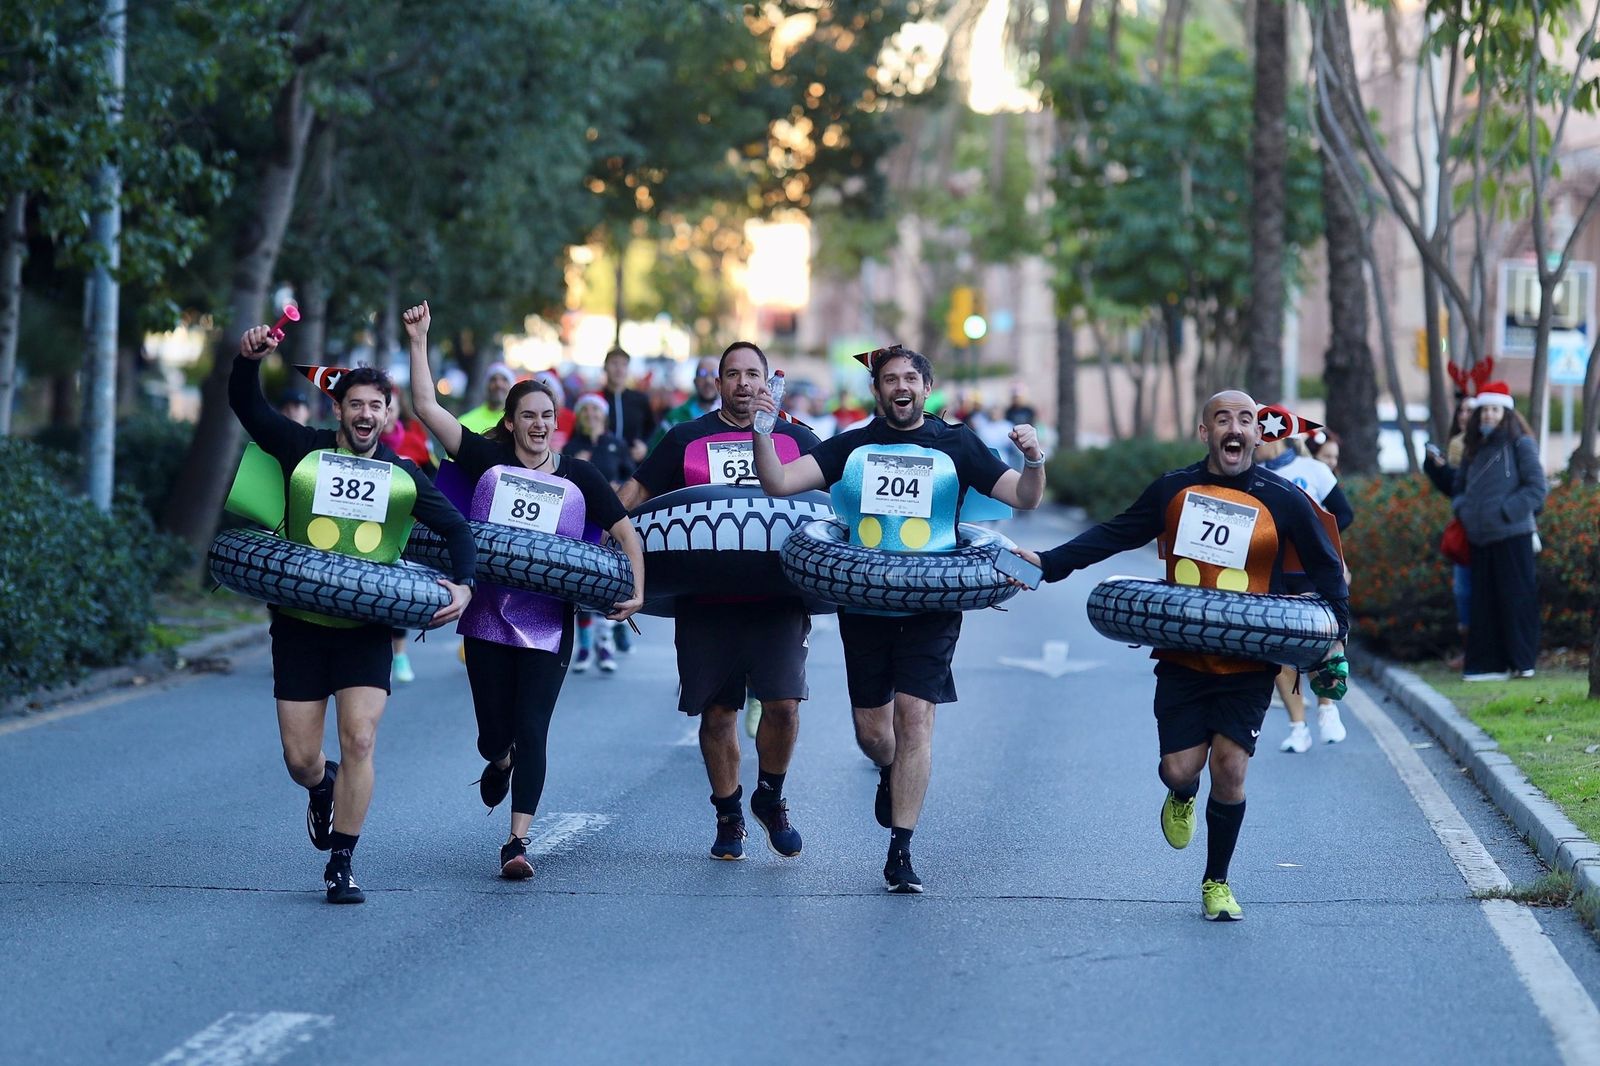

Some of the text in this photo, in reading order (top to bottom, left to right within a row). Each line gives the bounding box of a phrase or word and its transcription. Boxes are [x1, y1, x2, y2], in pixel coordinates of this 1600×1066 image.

[330, 477, 376, 502] 382
[875, 476, 920, 498] 204
[511, 498, 541, 522] 89
[1200, 520, 1230, 546] 70
